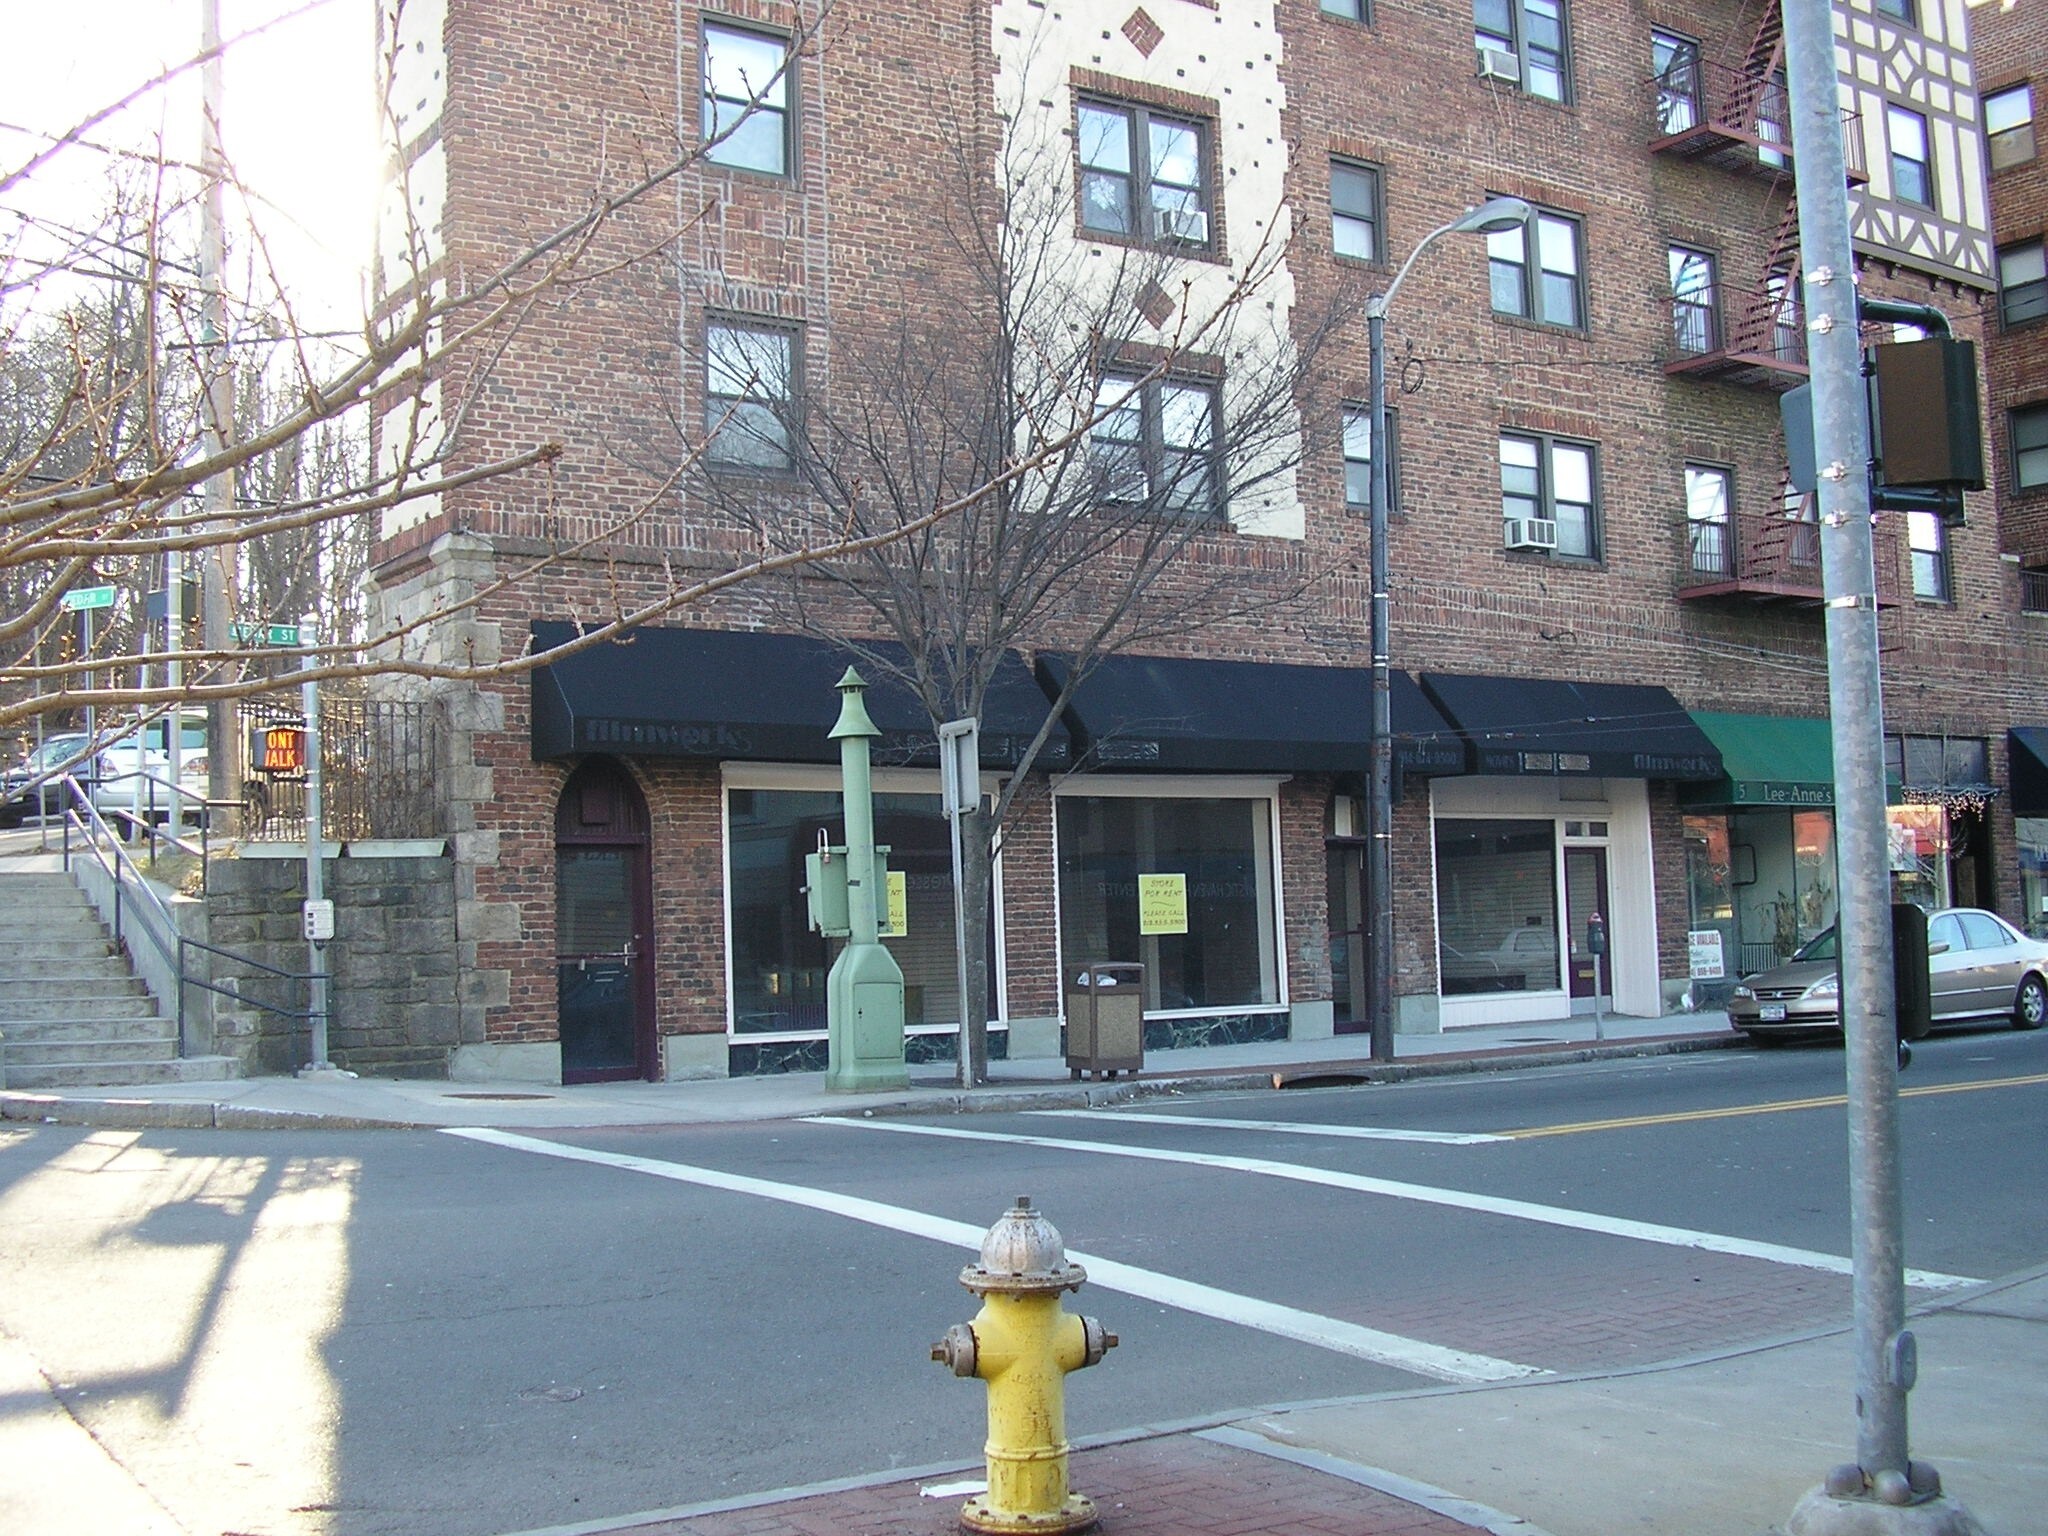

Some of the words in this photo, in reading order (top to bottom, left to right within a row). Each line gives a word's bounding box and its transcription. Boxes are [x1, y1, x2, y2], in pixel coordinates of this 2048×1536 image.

[281, 629, 294, 641] ST
[267, 731, 295, 749] ONT
[1738, 784, 1746, 799] 5
[1763, 784, 1832, 802] Lee-Anne's
[1144, 889, 1161, 898] FOR
[1163, 889, 1183, 898] RENT
